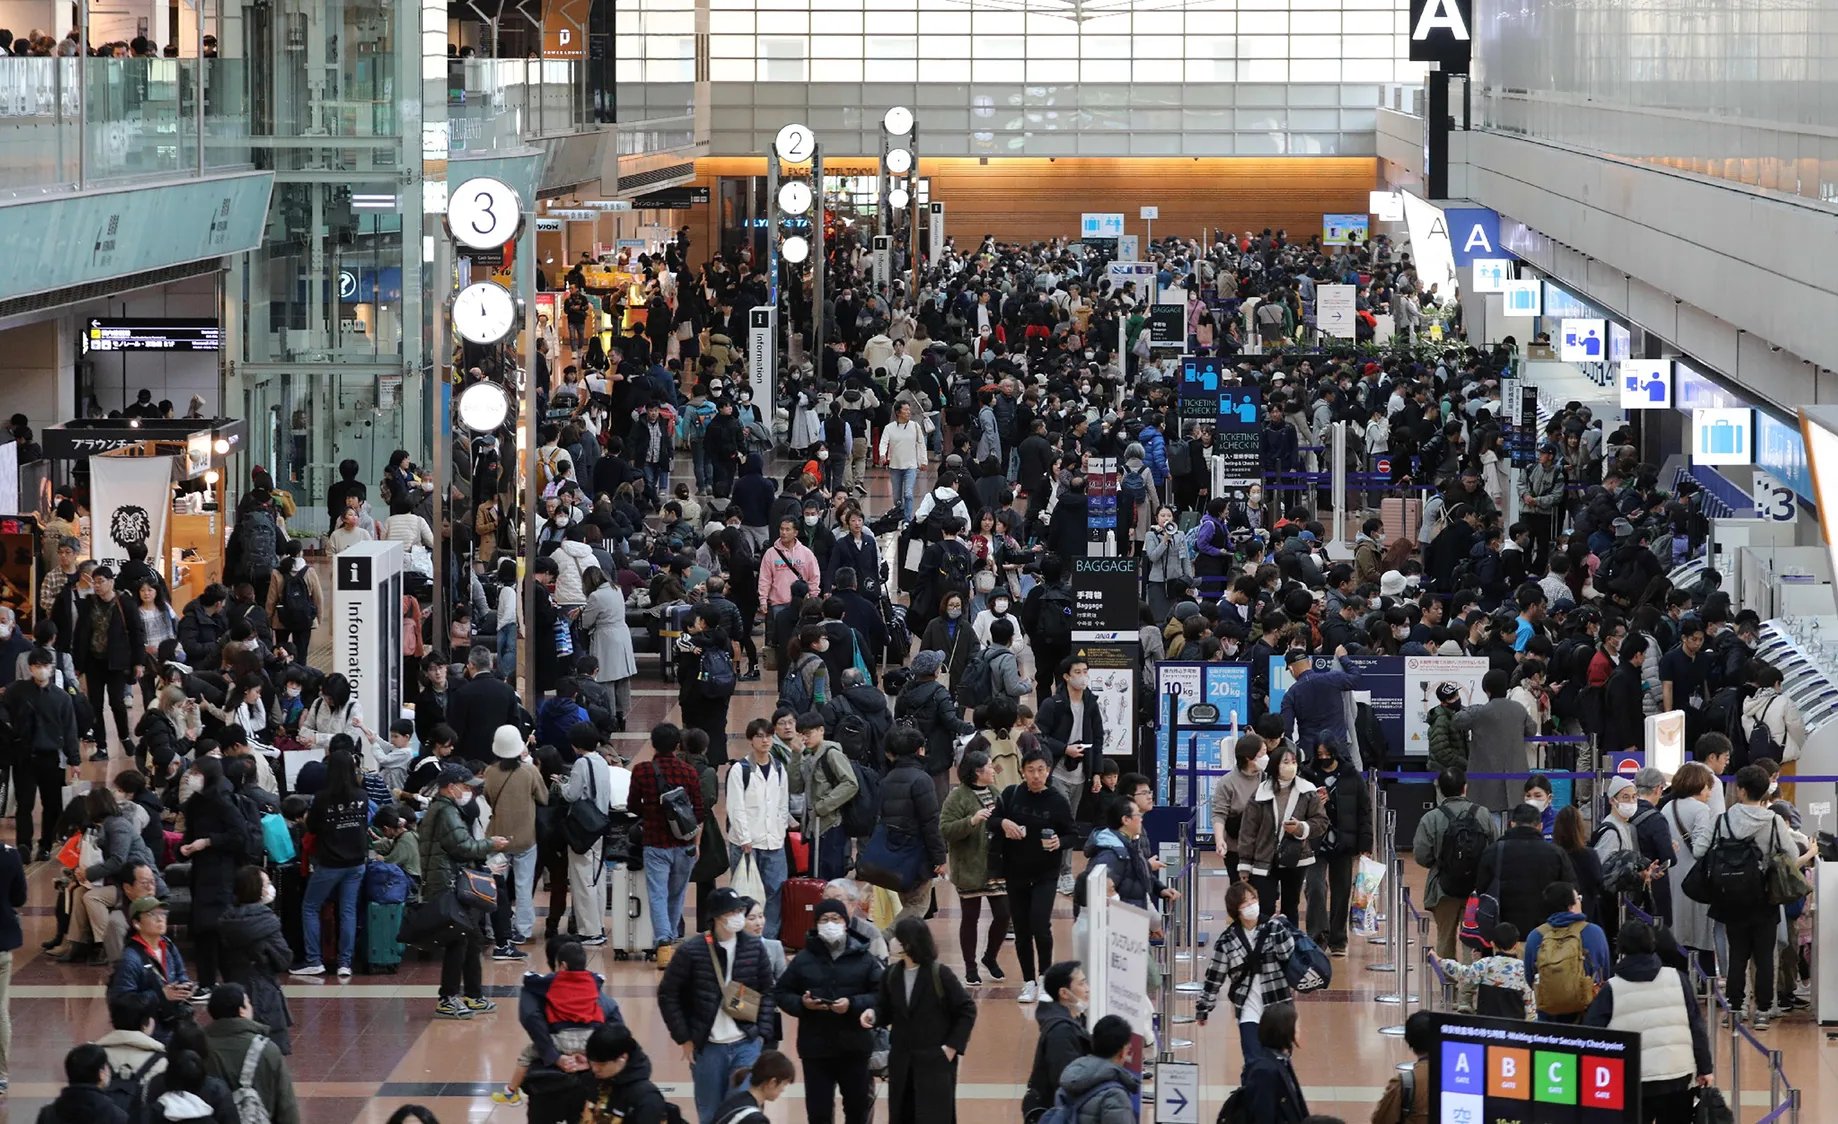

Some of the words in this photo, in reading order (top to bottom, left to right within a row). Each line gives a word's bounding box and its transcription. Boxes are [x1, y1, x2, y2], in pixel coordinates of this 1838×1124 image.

[1411, 0, 1470, 40] A
[789, 131, 802, 155] 2
[788, 167, 811, 176] EXCE
[823, 167, 844, 176] OTEL
[847, 167, 876, 176] TOKYU
[471, 191, 497, 235] 3
[1427, 217, 1448, 240] A
[1463, 223, 1492, 253] A
[1152, 306, 1181, 314] BAGGAGE
[1698, 409, 1705, 421] 7
[1219, 432, 1260, 441] TICKETING
[1250, 441, 1260, 449] IN
[1076, 560, 1135, 572] BAGGAGE
[1076, 590, 1103, 600] 手荷物
[1076, 602, 1104, 610] Baggage
[1164, 681, 1182, 696] 10
[1183, 688, 1194, 696] kg
[1210, 681, 1230, 696] 20
[1230, 688, 1240, 697] kg
[1160, 732, 1169, 805] ENTRANCE
[1296, 977, 1324, 990] adidas
[1533, 1034, 1550, 1044] time
[1559, 1037, 1586, 1049] Security
[1455, 1052, 1470, 1073] A
[1502, 1057, 1516, 1078] B
[1548, 1061, 1562, 1082] C
[1595, 1066, 1610, 1088] D
[1455, 1076, 1470, 1084] GATE
[1501, 1081, 1516, 1089] GATE
[1548, 1086, 1563, 1094] GATE
[1595, 1091, 1610, 1099] GATE
